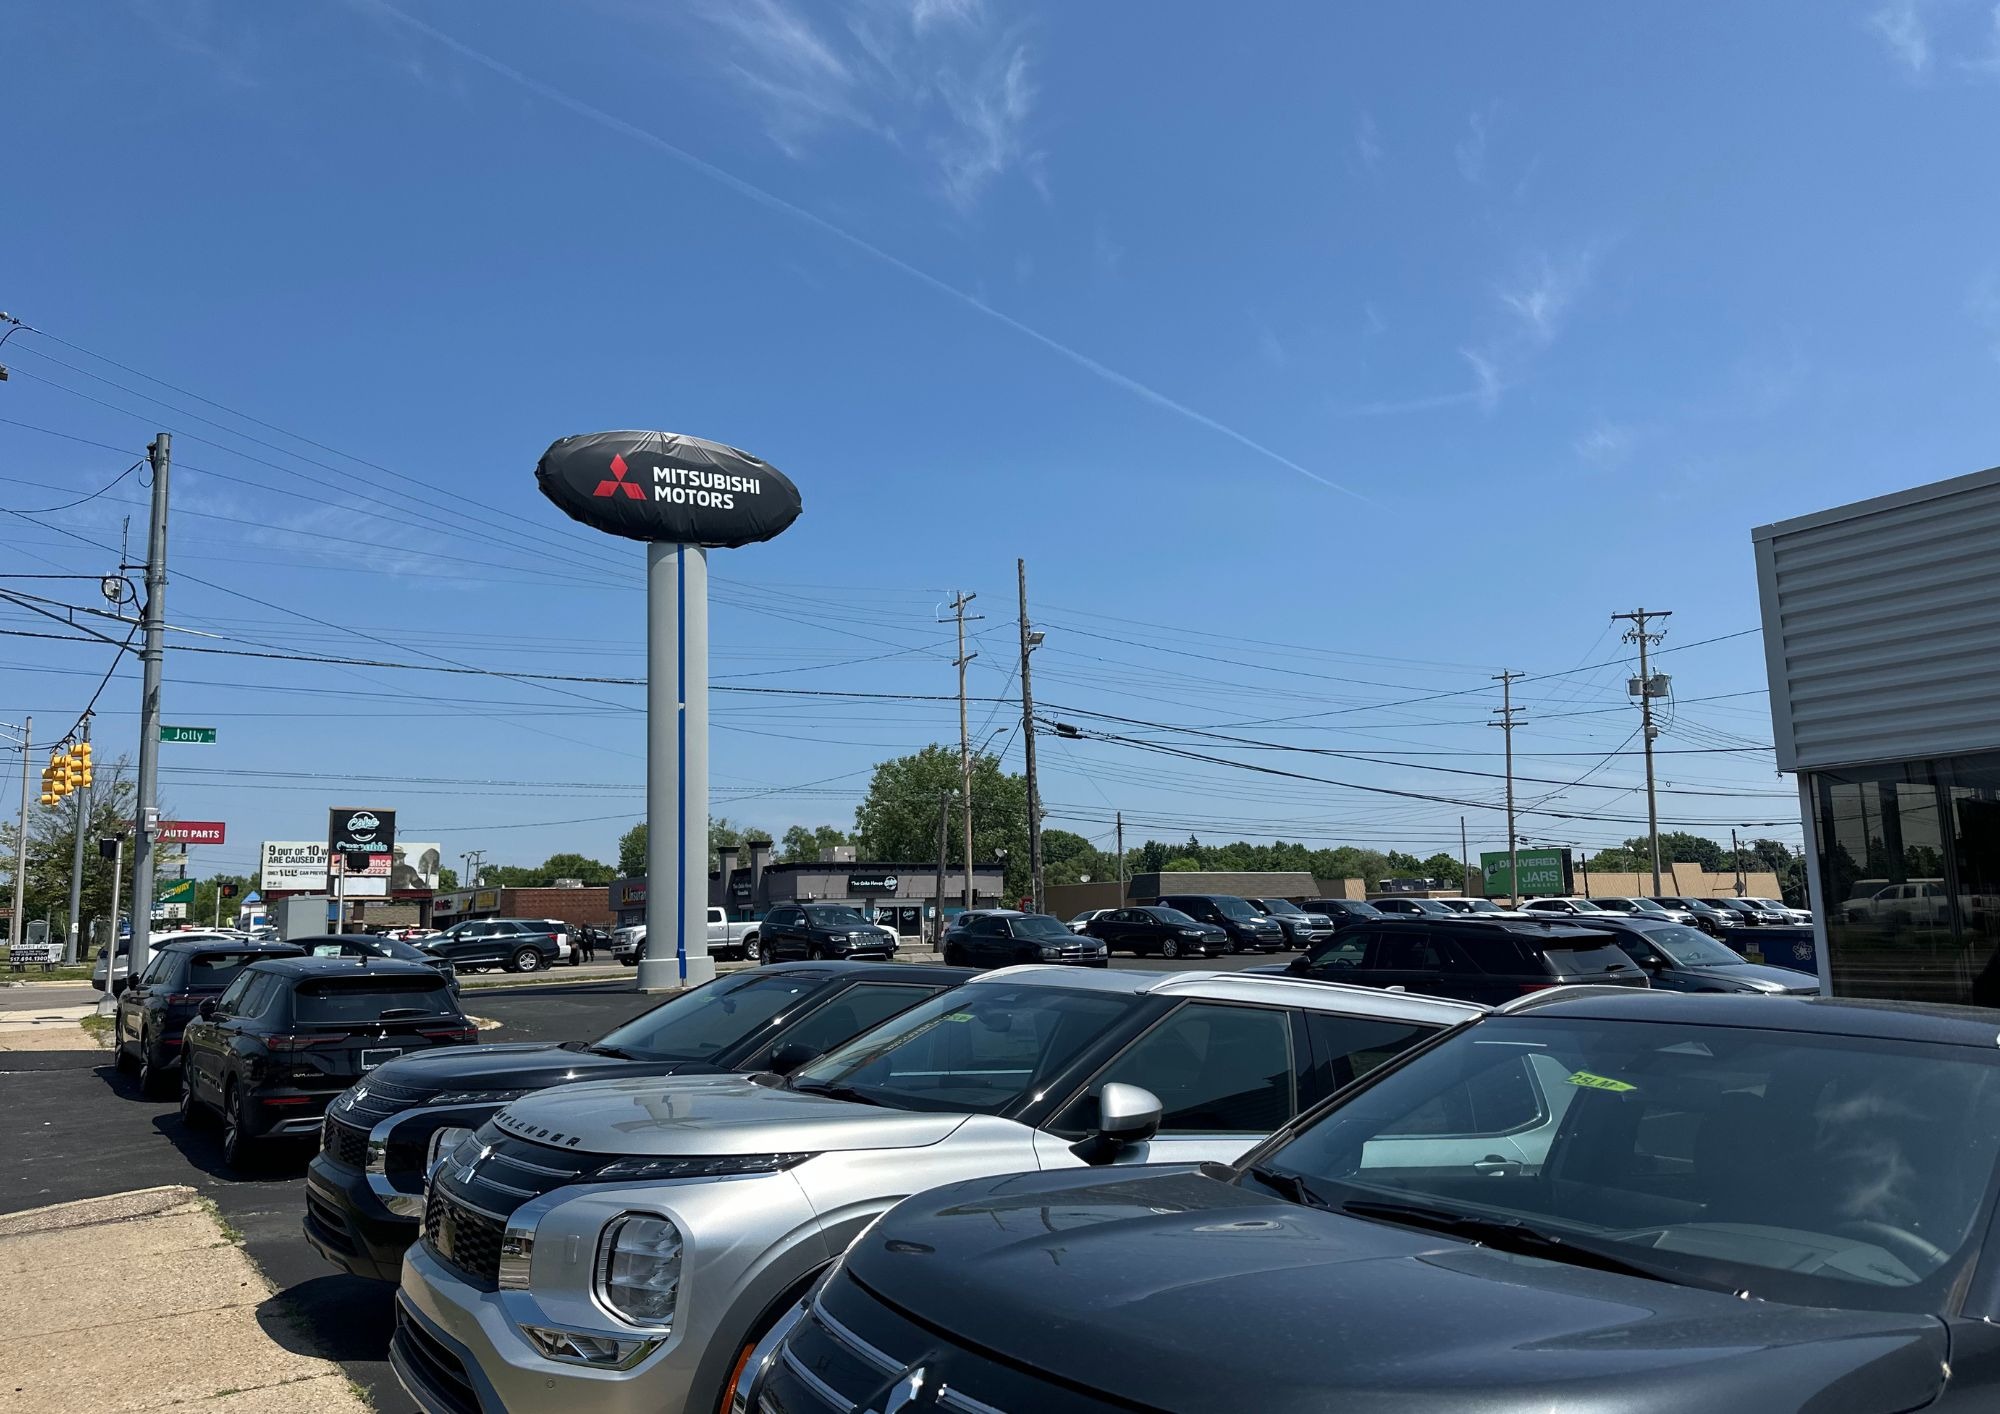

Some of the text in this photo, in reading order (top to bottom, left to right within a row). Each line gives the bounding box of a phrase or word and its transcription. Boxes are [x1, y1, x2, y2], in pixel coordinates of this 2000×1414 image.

[653, 466, 761, 495] MITSUBISHI
[654, 486, 734, 510] MOTORS
[174, 728, 203, 743] Jolly
[347, 816, 380, 831] Cake
[164, 829, 188, 838] AUTO
[191, 829, 220, 839] PARTS
[268, 845, 276, 856] 9
[278, 848, 293, 856] OUT
[295, 848, 304, 856] OF
[306, 845, 319, 856] 10
[268, 856, 327, 864] ARE CAUSED BY
[1522, 871, 1558, 883] JARS
[160, 880, 192, 901] SUBWAY
